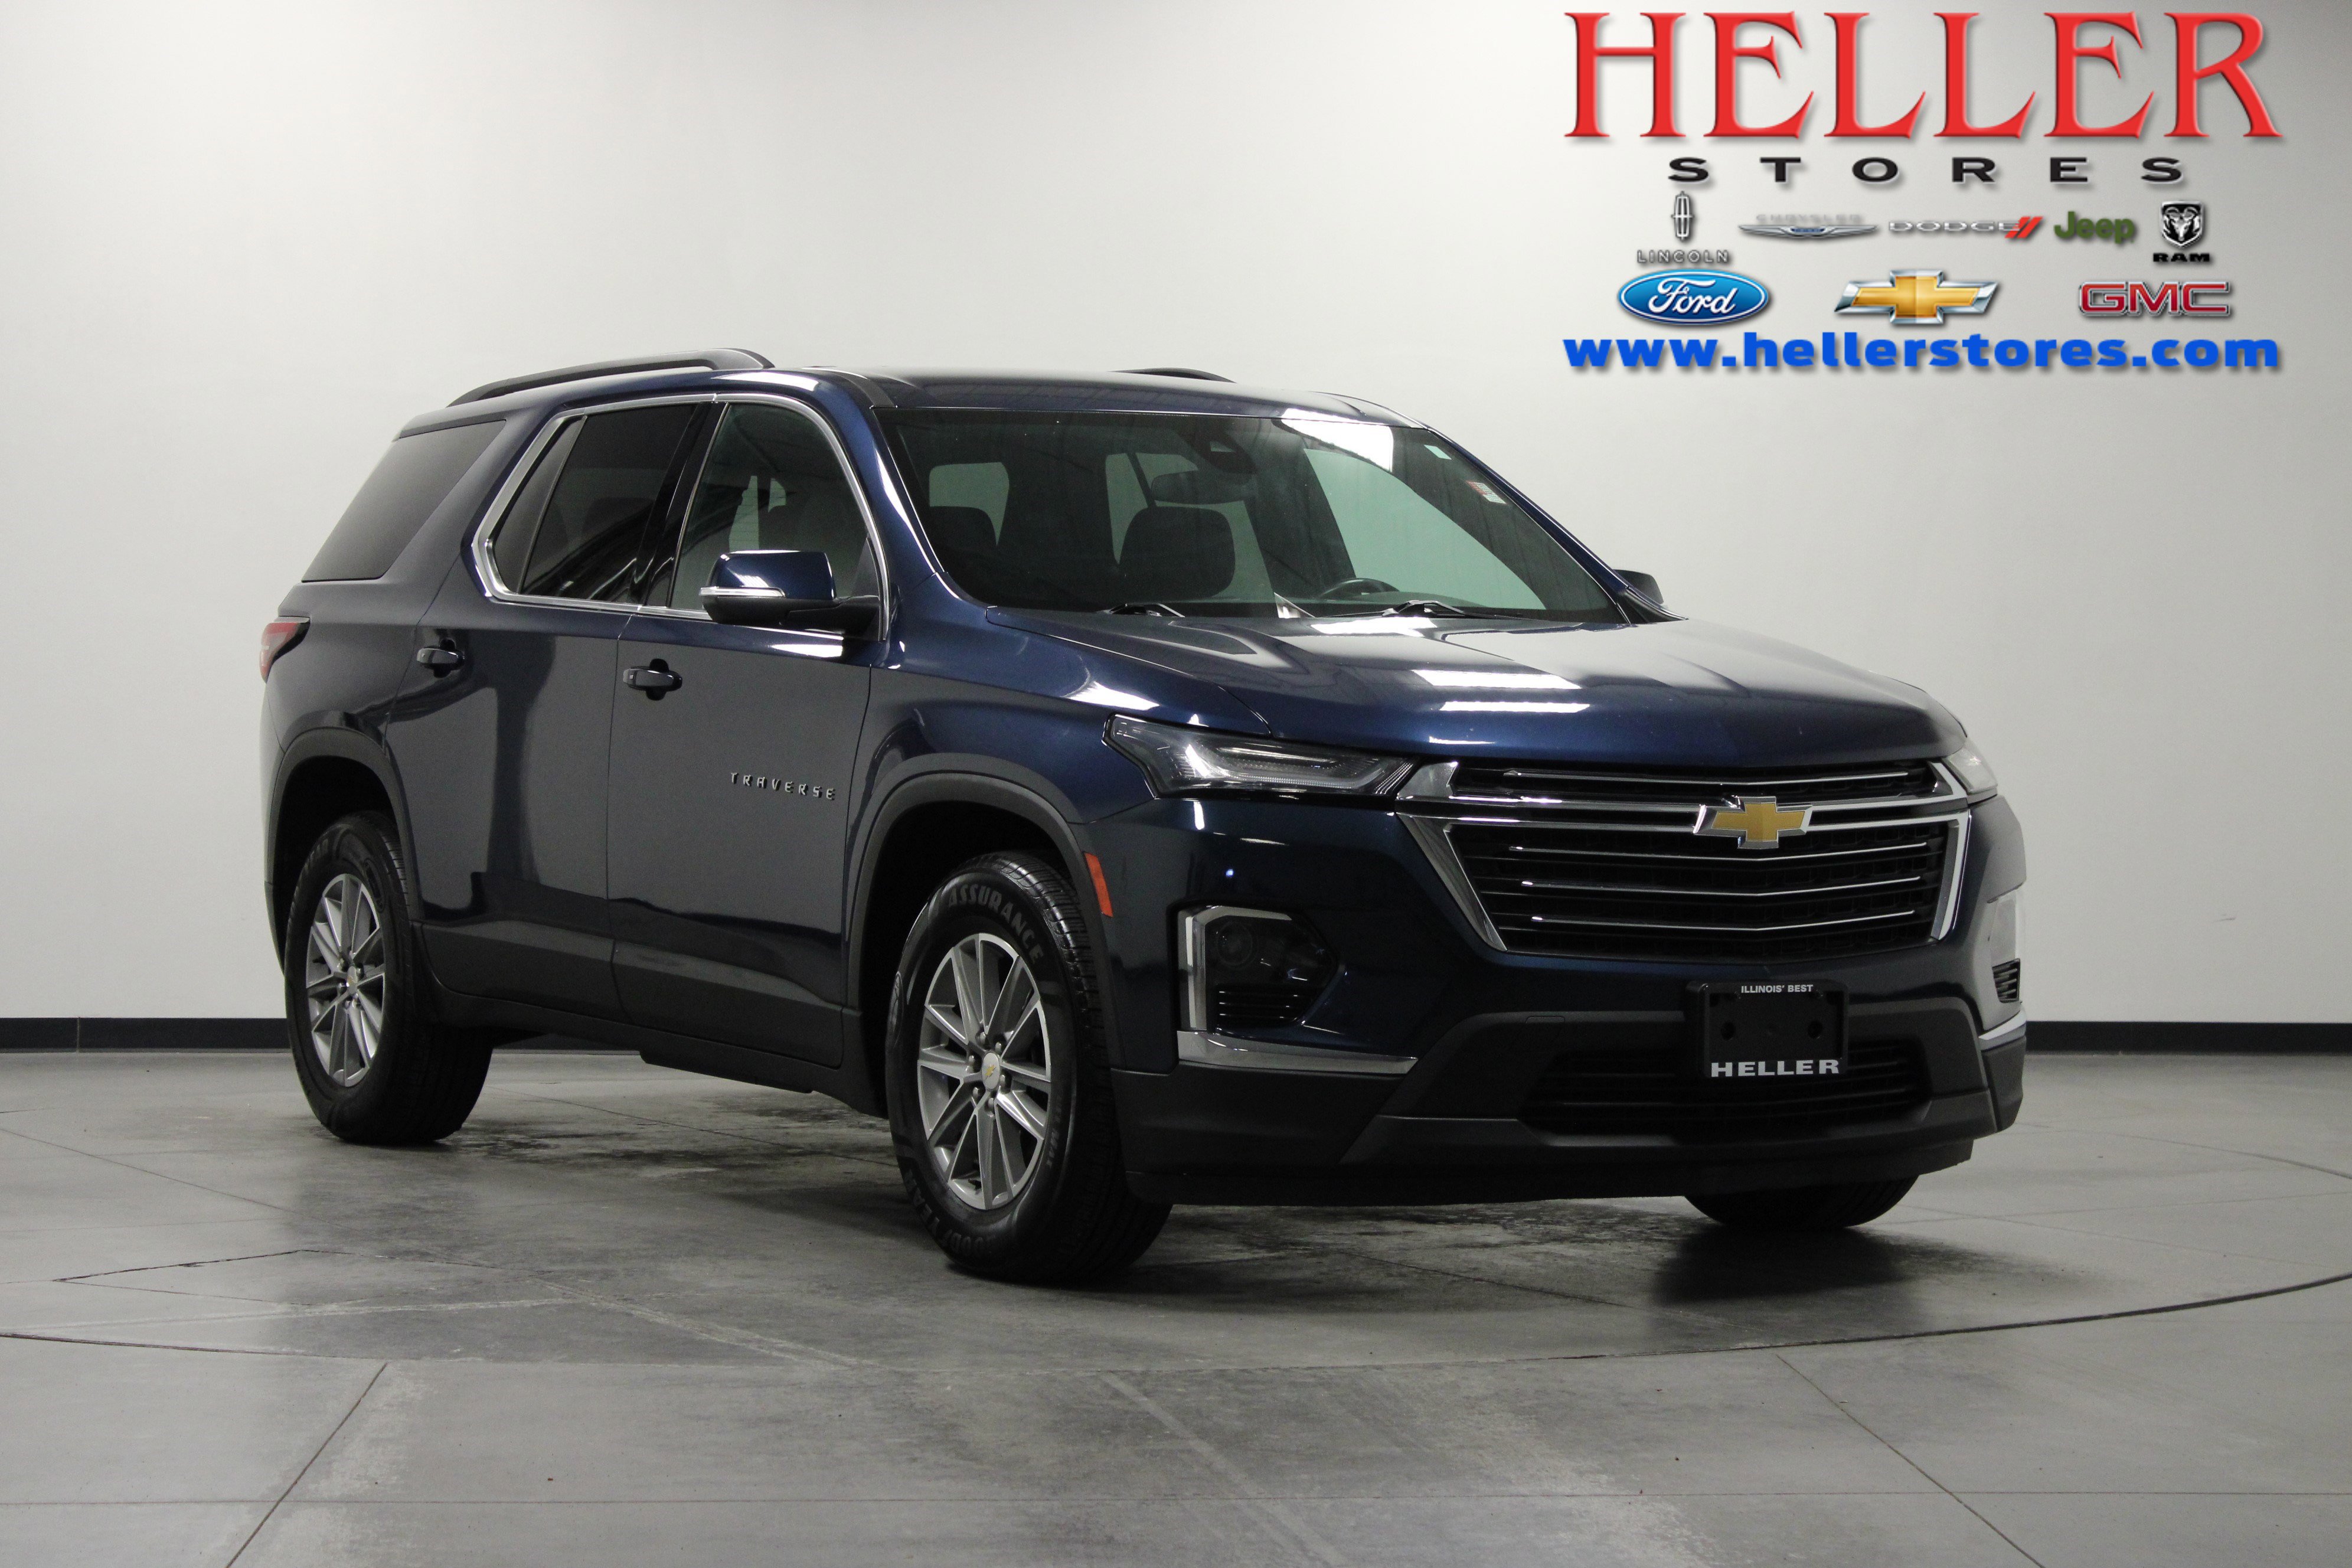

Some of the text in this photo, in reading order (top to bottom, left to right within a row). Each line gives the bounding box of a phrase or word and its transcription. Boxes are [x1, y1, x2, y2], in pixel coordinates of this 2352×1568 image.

[730, 772, 835, 801] TRAVERSE
[948, 883, 1044, 965] ASSURANCE
[1741, 984, 1814, 993] ILLINOIS' BEST
[1711, 1059, 1840, 1077] HELLER
